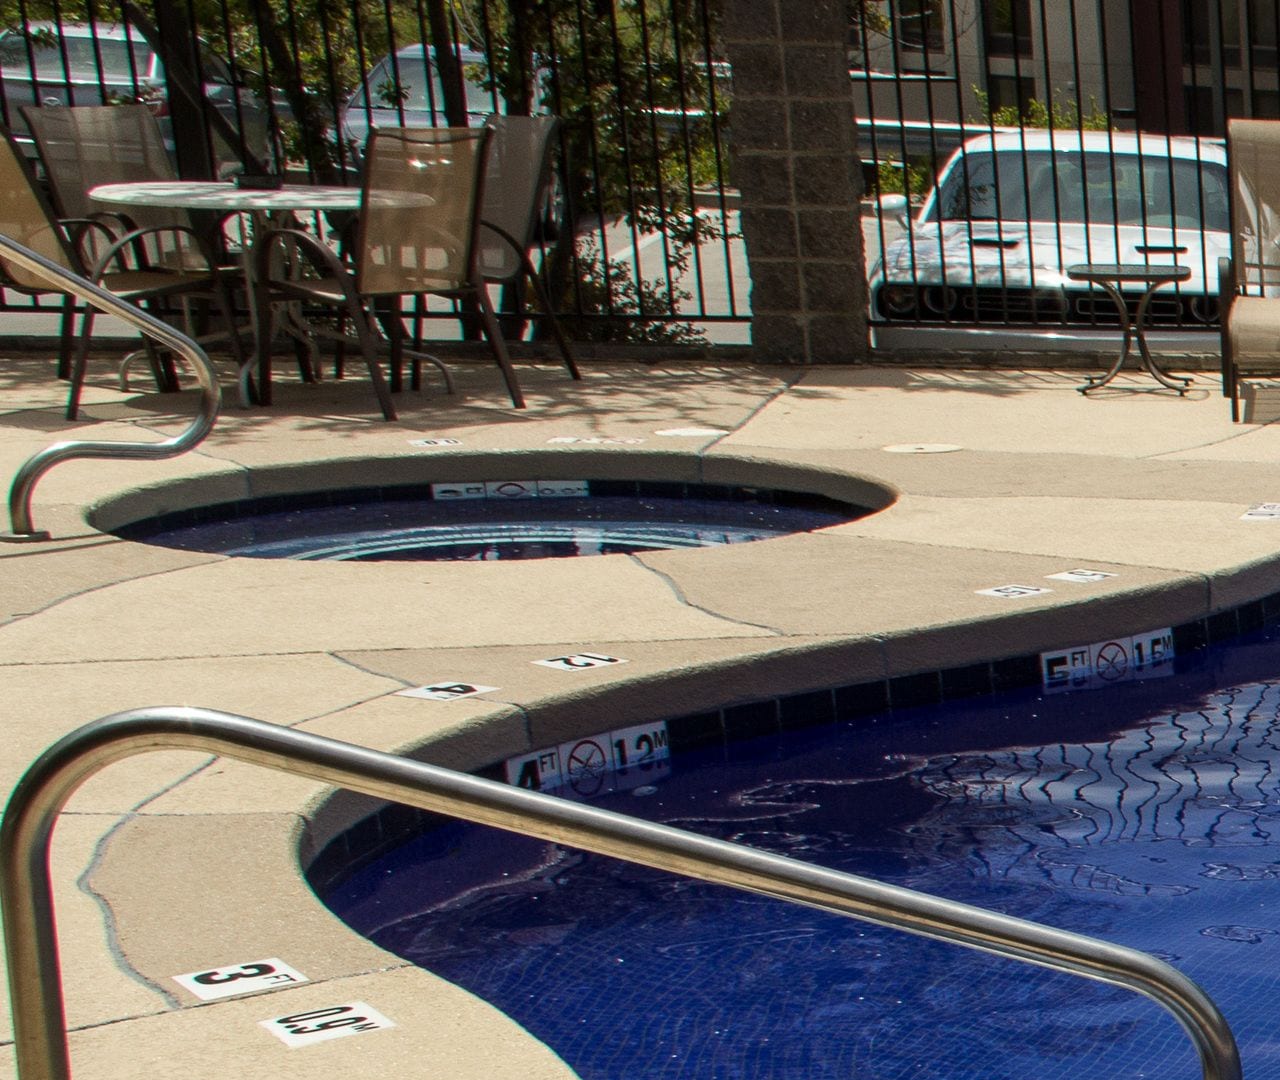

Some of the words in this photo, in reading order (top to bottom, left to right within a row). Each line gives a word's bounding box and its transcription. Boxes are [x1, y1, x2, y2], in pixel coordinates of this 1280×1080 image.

[539, 752, 557, 772] FT
[193, 963, 276, 985] 3
[263, 973, 297, 985] FT
[276, 1006, 369, 1035] 0.9
